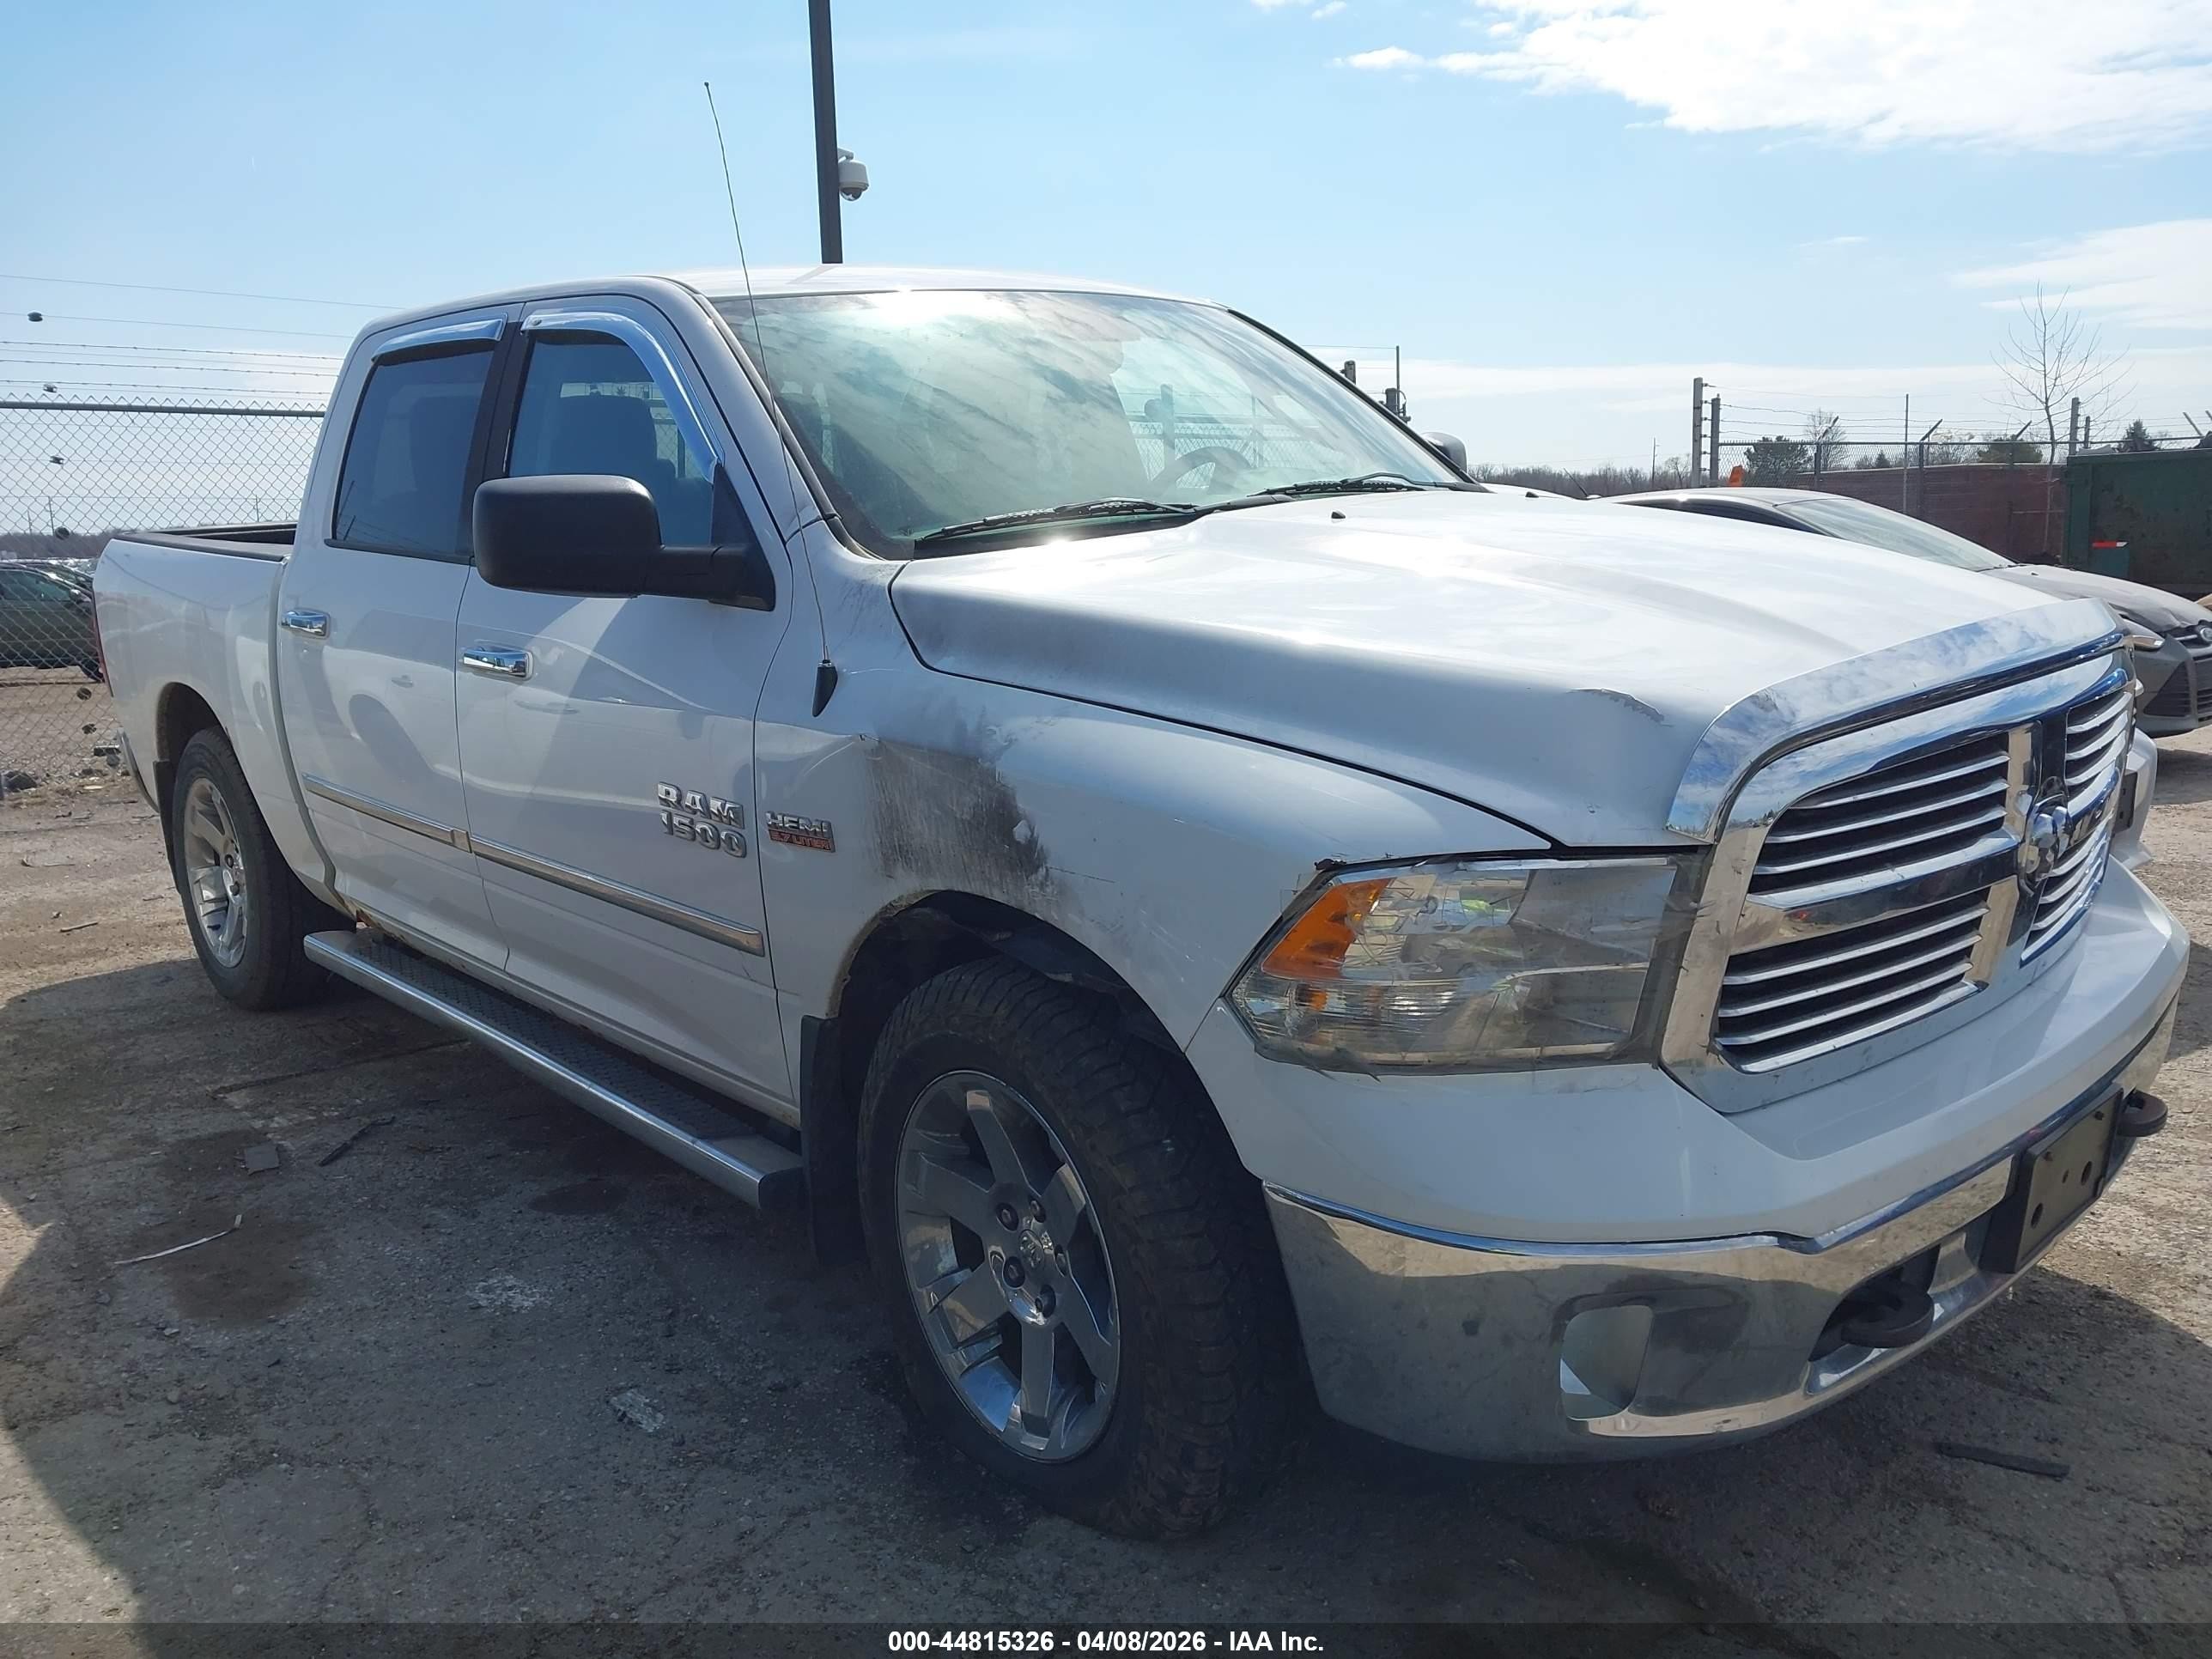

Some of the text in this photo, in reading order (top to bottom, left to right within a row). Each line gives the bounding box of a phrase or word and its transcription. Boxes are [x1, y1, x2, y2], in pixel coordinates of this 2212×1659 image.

[658, 781, 745, 830] RAM
[765, 811, 832, 835] HEMI
[660, 809, 748, 858] 1500
